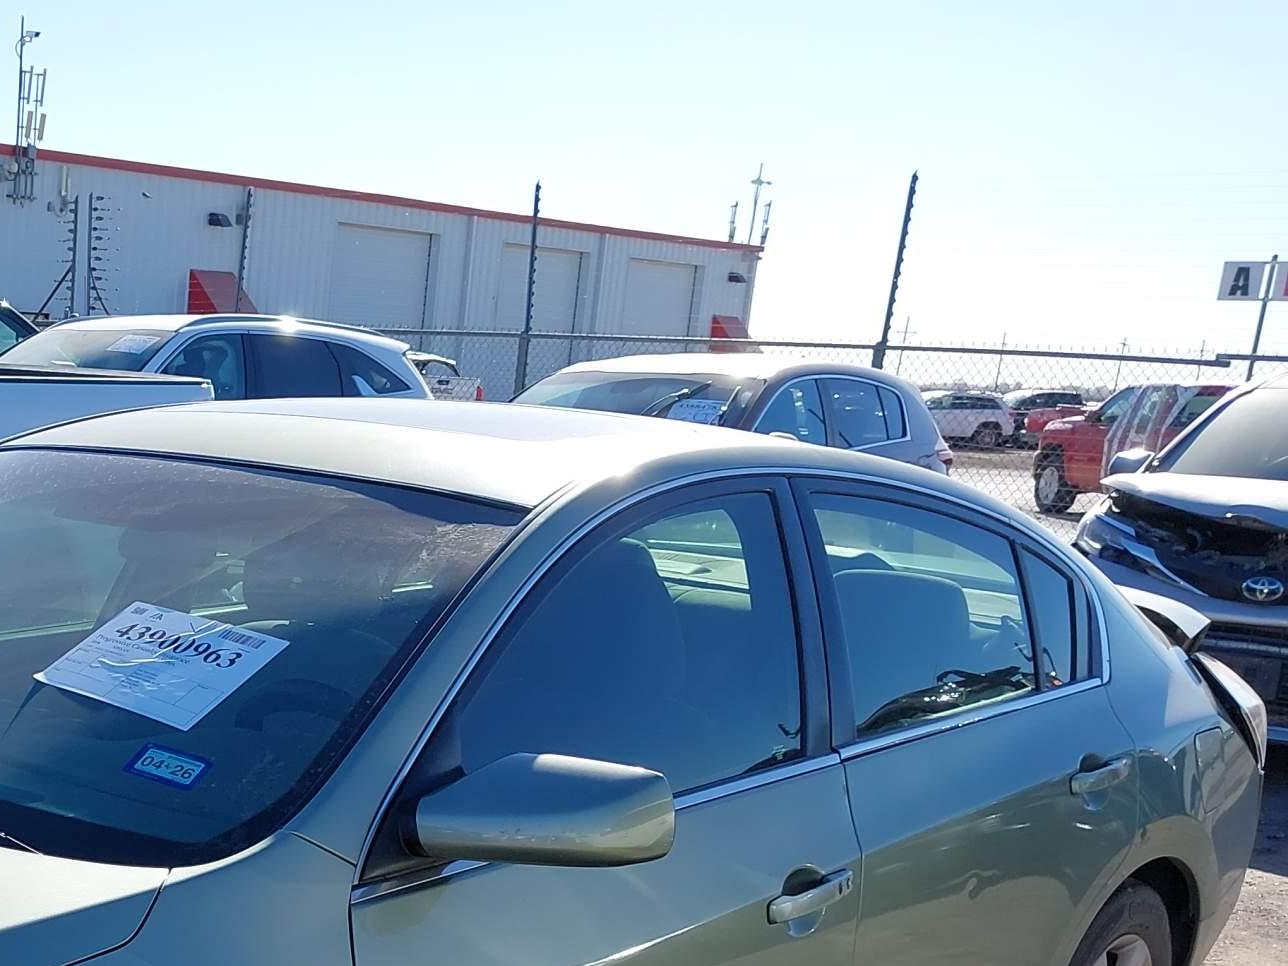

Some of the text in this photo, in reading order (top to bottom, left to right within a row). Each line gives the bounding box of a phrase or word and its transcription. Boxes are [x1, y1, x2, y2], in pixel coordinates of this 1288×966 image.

[1228, 267, 1250, 296] A
[114, 623, 243, 669] 43900963
[140, 756, 165, 770] 04
[169, 764, 196, 780] 26
